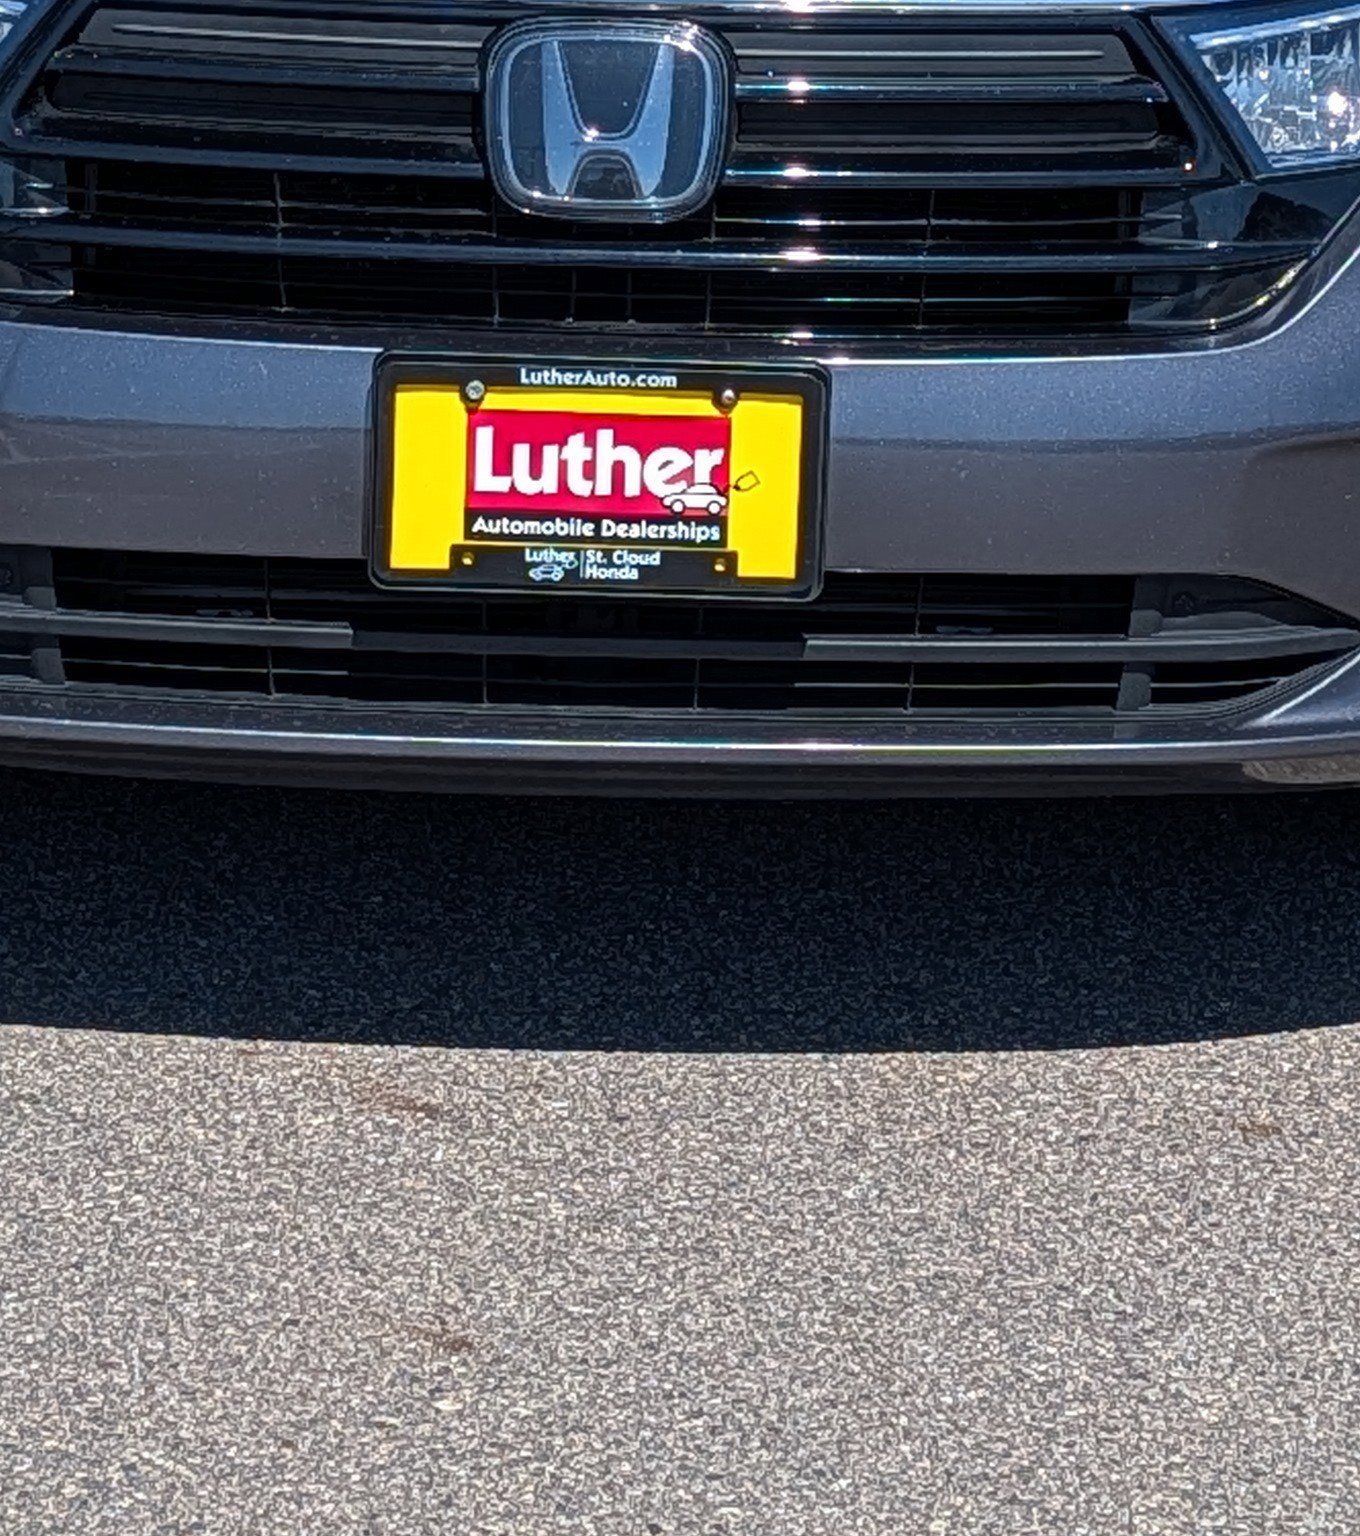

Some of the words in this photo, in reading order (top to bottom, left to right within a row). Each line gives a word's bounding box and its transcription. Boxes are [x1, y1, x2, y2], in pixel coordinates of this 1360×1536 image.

[519, 367, 678, 388] LutherAuto.com
[473, 425, 725, 498] Luther
[471, 516, 595, 537] Automobile
[600, 521, 721, 543] Dealerships
[524, 548, 577, 564] Luther
[585, 550, 608, 565] St.
[612, 551, 661, 565] Cloud
[584, 565, 639, 580] Honda
